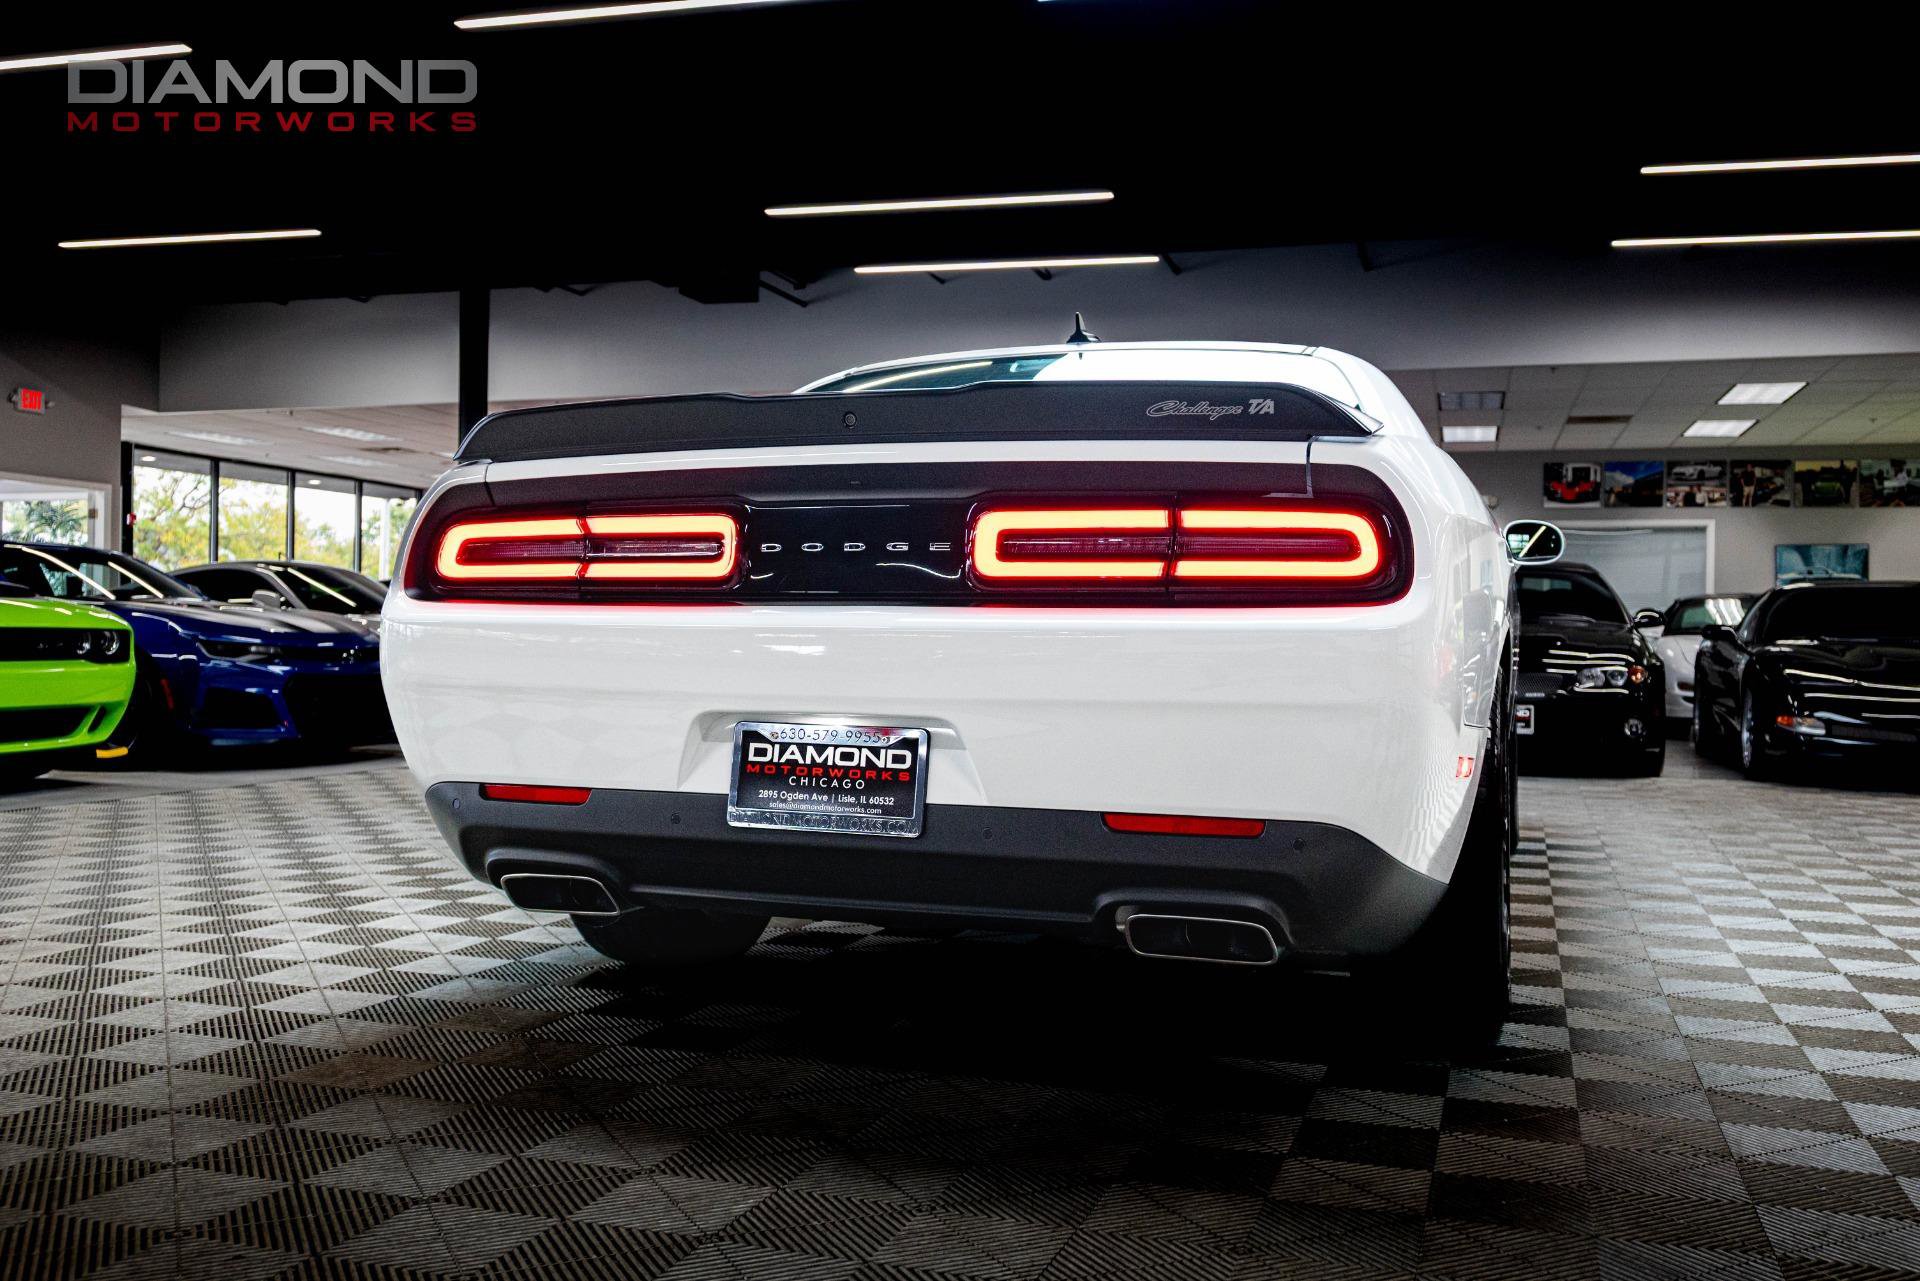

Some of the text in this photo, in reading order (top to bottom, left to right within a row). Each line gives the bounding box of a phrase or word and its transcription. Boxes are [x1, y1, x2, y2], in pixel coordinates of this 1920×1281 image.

[21, 387, 43, 411] EXIT
[1146, 400, 1244, 421] Challenger
[760, 542, 951, 552] DODGE
[779, 727, 881, 744] 630-579-9955
[748, 742, 912, 769] DIAMOND
[746, 764, 911, 781] MOTORWORKS
[788, 776, 865, 789] CHICAGO
[758, 789, 778, 799] 2895
[780, 790, 810, 801] Ogden
[811, 792, 829, 801] Ave
[838, 794, 858, 804] Lisle,
[860, 795, 867, 804] IL
[869, 795, 895, 806] 60532
[769, 801, 882, 815] sales@diamondmotorworks.com
